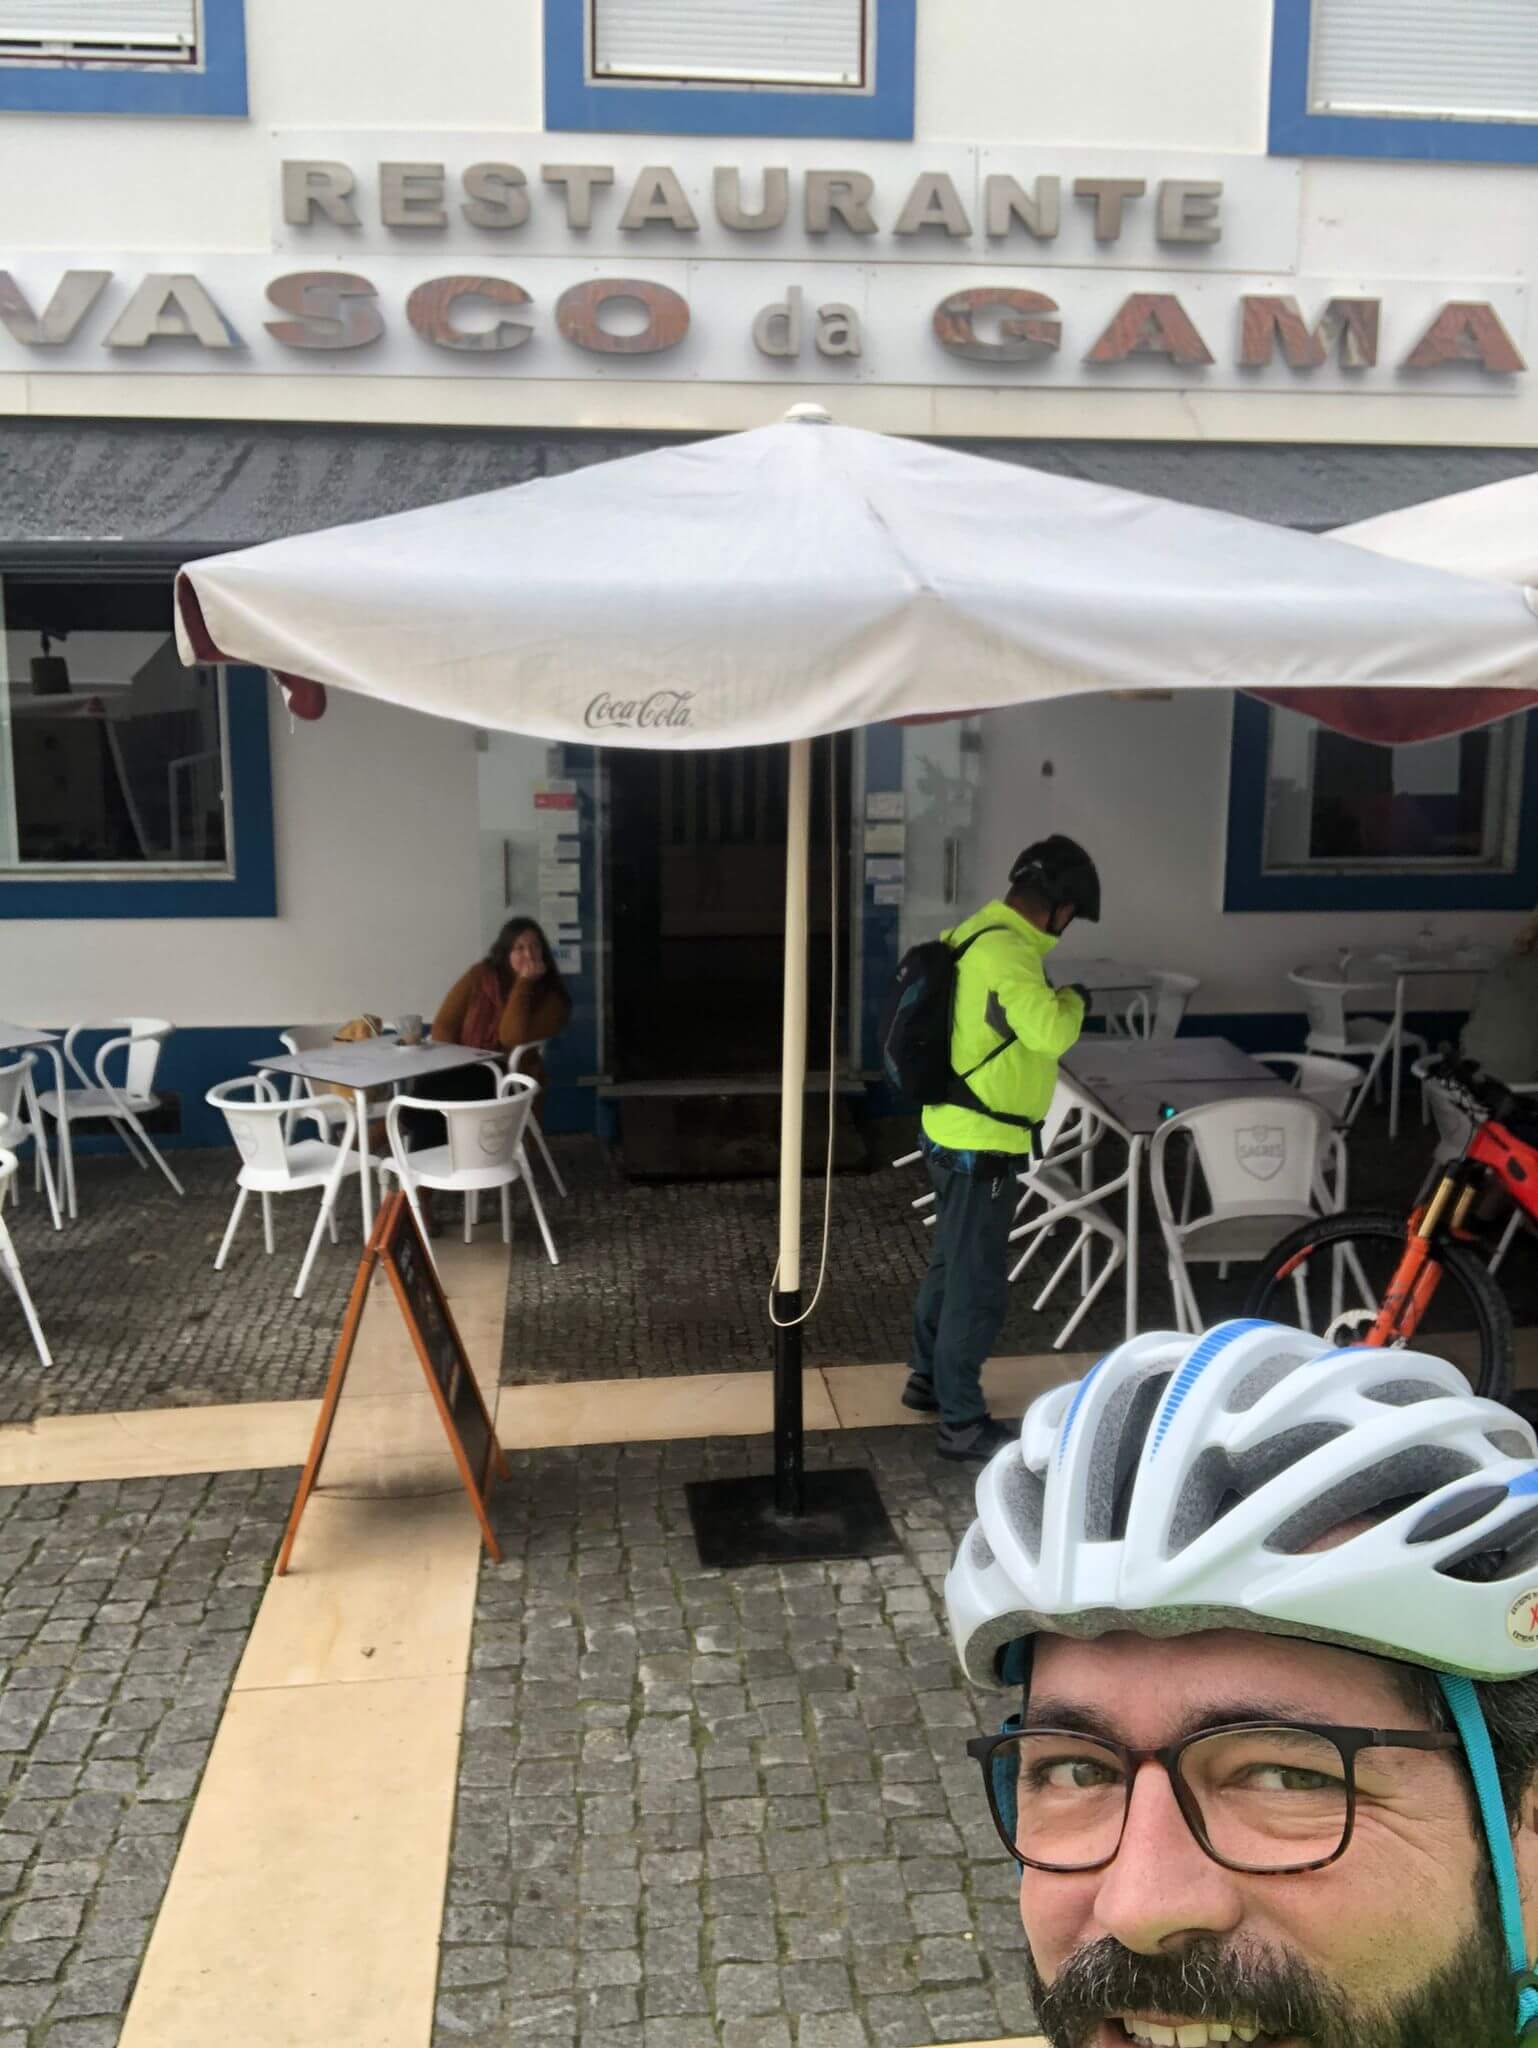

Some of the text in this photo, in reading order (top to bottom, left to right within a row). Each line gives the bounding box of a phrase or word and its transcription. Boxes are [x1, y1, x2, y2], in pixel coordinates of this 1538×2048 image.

[281, 160, 1223, 245] RESTAURANTE
[0, 269, 1528, 373] VASCO da GAMA
